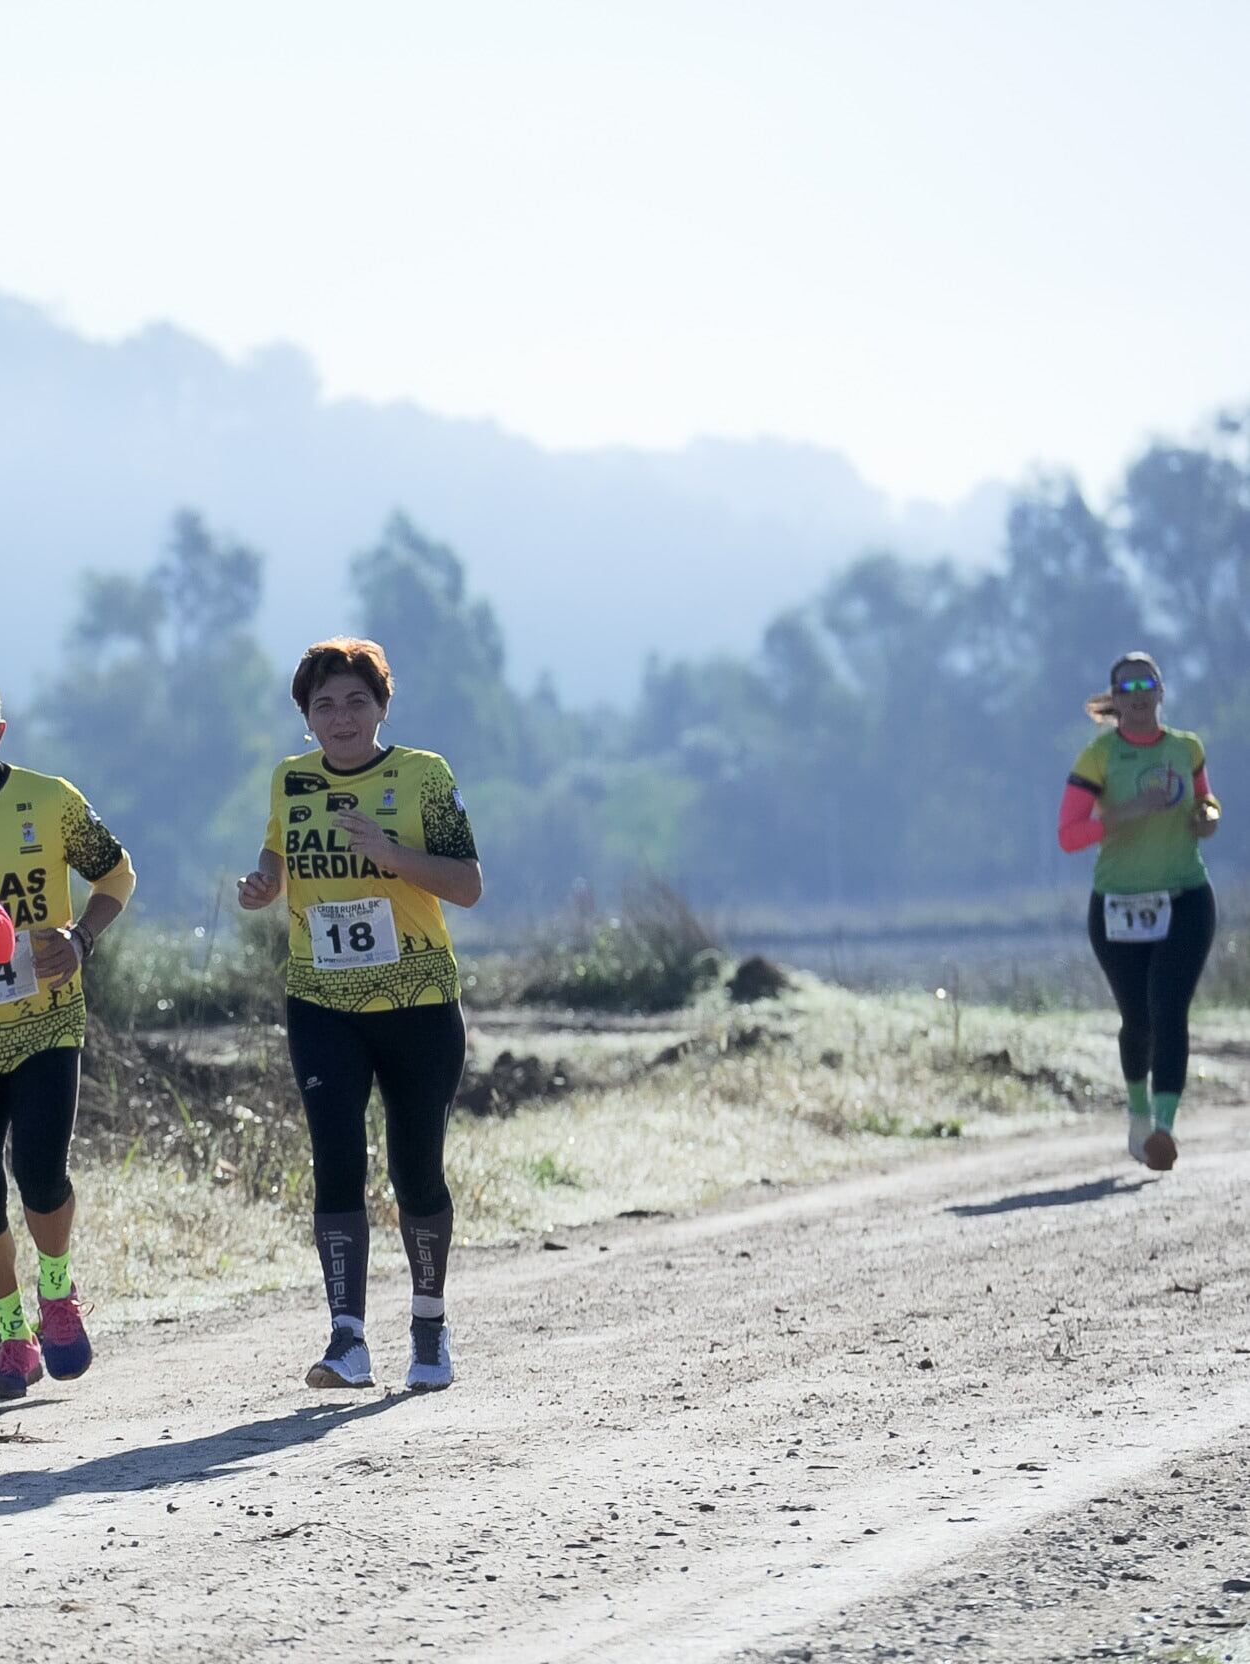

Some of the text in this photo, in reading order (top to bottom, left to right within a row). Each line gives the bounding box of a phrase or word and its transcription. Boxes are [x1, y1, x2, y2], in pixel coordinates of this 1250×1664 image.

[317, 905, 339, 914] CROSS
[340, 903, 366, 913] RURAL
[326, 921, 375, 954] 18
